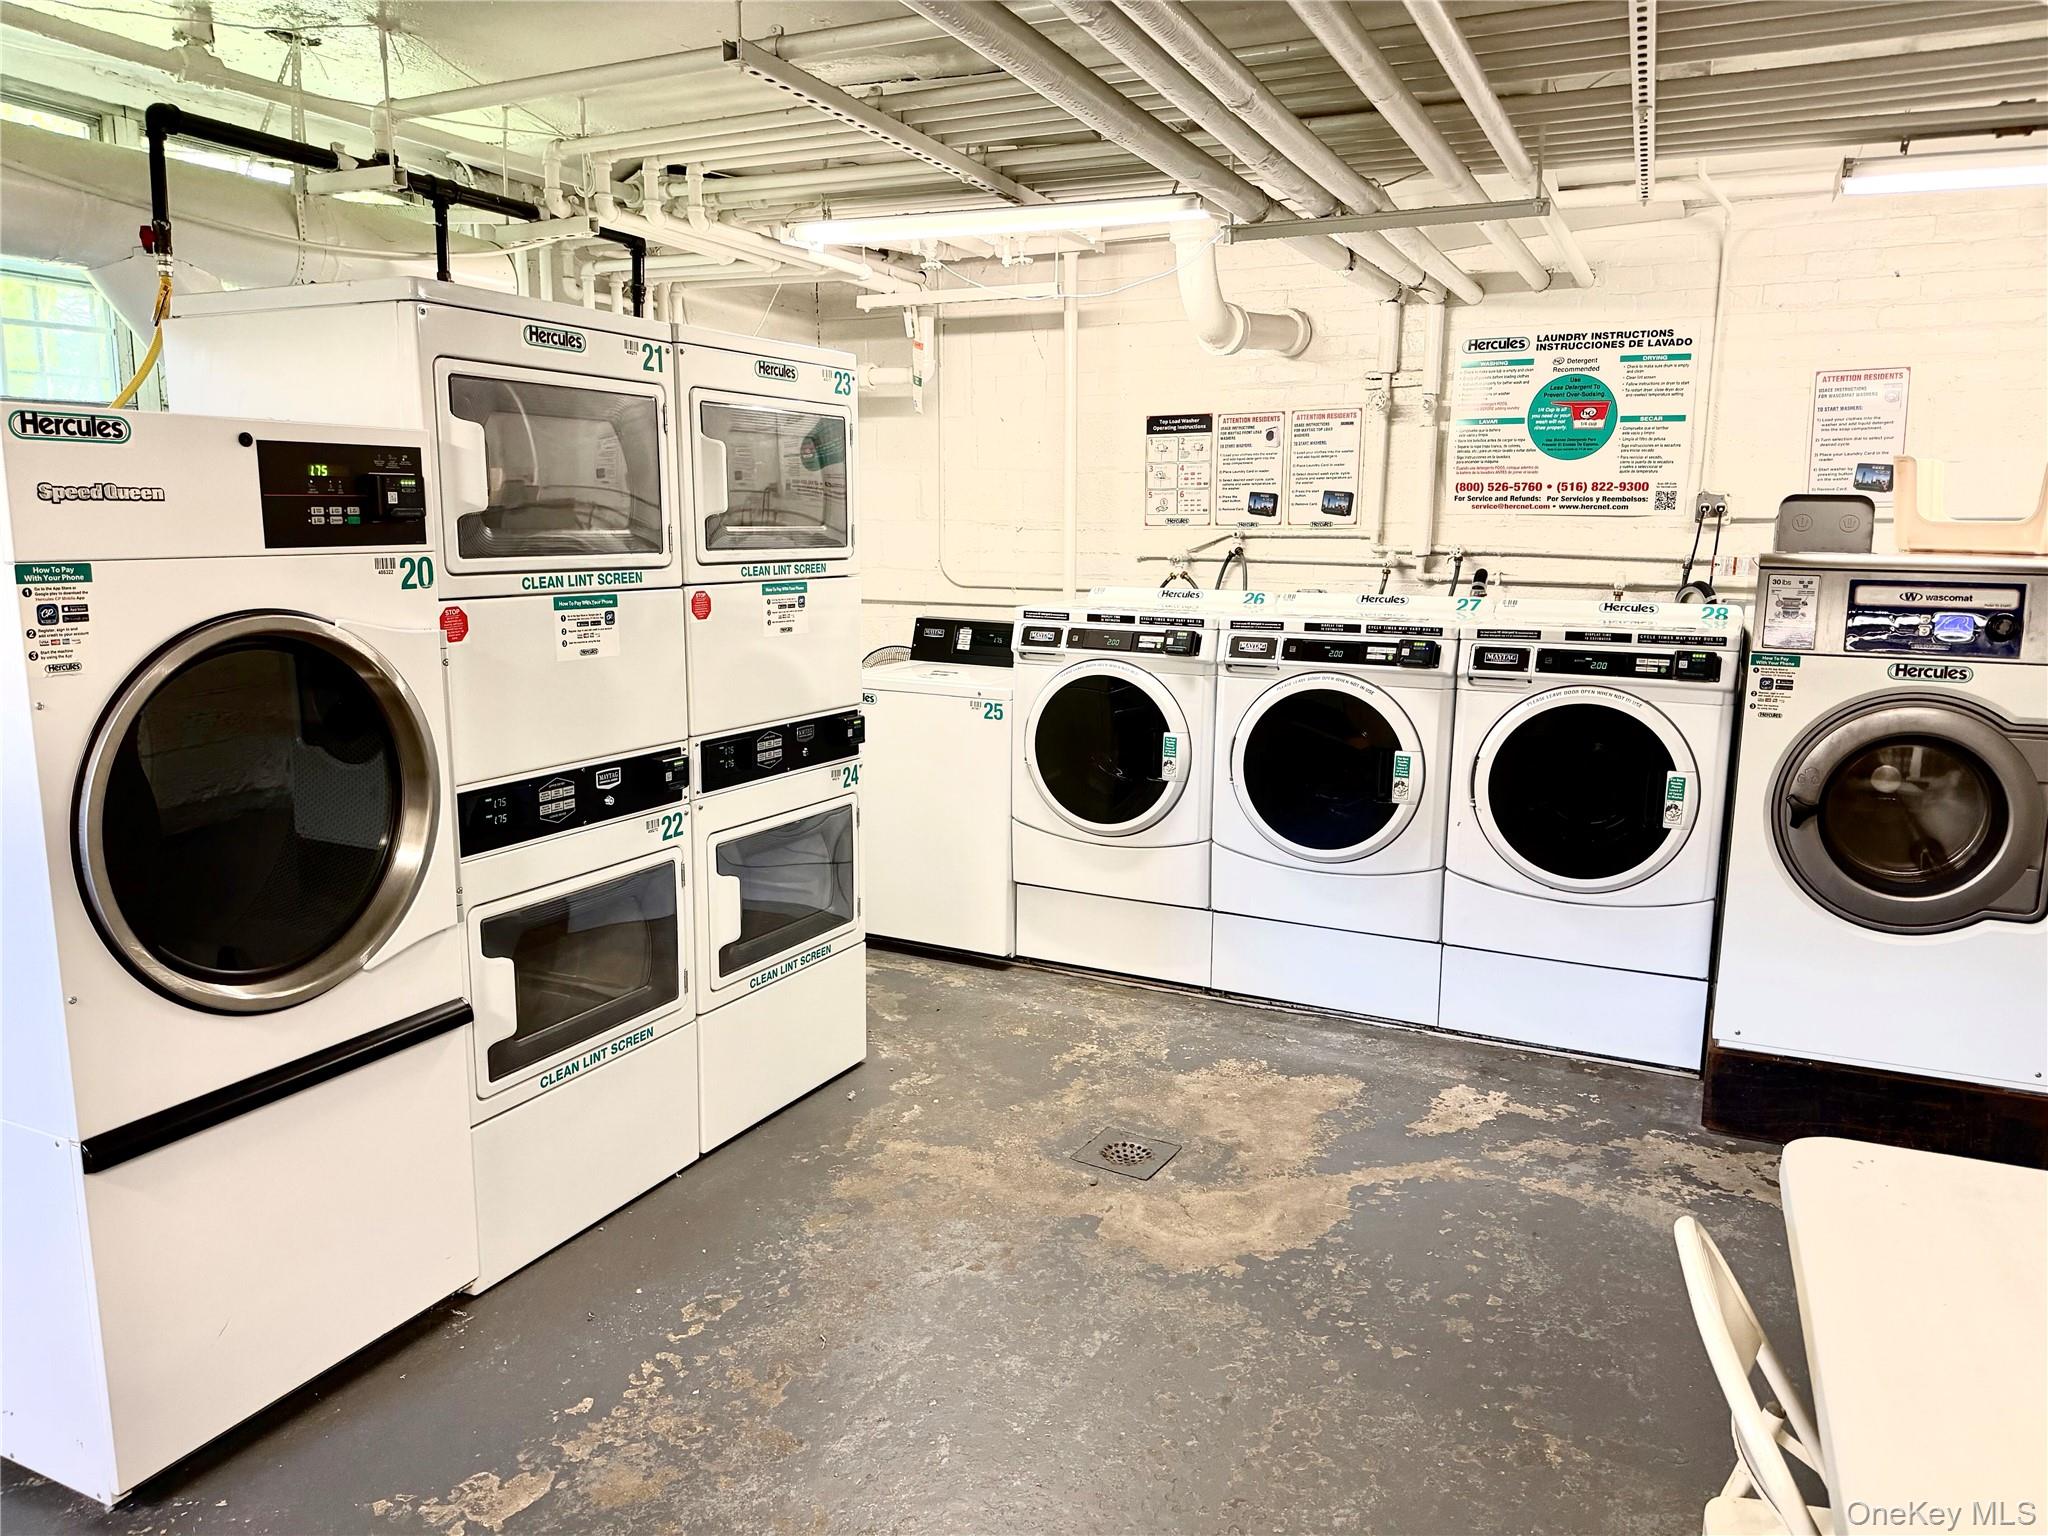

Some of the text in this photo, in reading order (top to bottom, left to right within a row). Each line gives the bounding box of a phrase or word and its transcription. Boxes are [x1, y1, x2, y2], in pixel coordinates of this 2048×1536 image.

[529, 325, 583, 349] Hercules
[1537, 329, 1674, 343] LAUNDRY INSTRUCTIONS
[1468, 338, 1526, 351] Hercules
[1536, 338, 1693, 351] INSTRUCCIONES DE LAVADO
[642, 343, 663, 372] 21
[1567, 357, 1598, 365] Detergent
[758, 361, 796, 379] Hercules
[834, 371, 851, 396] 23
[1822, 372, 1904, 383] ATTENTION RESIDENTS
[19, 411, 124, 438] Hercules
[1252, 415, 1281, 423] RESIDENTS
[37, 482, 166, 504] Speed Queen
[1455, 482, 1484, 493] (800)
[1487, 482, 1543, 492] 526-5760
[1556, 482, 1588, 493] (516)
[1591, 481, 1649, 492] 822-9300
[1601, 495, 1649, 503] Reembolsos:
[51, 566, 60, 574] To
[61, 566, 75, 574] Pay
[400, 556, 434, 590] 20
[741, 563, 827, 577] CLEAN LINT SCREEN
[24, 573, 85, 582] With Your Phone
[522, 571, 643, 590] CLEAN LINT SCREEN
[1161, 590, 1200, 599] Hercules
[1243, 592, 1266, 605] 26
[1360, 594, 1406, 604] Hercules
[1925, 593, 1973, 602] wascomat
[1455, 598, 1482, 611] 27
[1604, 602, 1655, 613] Hercules
[1701, 606, 1729, 621] 28
[28, 630, 34, 638] 2
[30, 652, 36, 660] 3
[1487, 653, 1517, 661] MAYTAG
[48, 663, 80, 672] Hercules
[1894, 663, 1967, 680] Hercules
[1526, 697, 1545, 708] PLEASE
[1545, 691, 1562, 700] LEAVE
[1597, 690, 1613, 698] WHEN
[1632, 700, 1643, 709] USE
[983, 702, 1004, 721] 25
[599, 771, 619, 781] MAYTAG
[843, 764, 859, 788] 24
[661, 812, 684, 842] 22
[749, 944, 832, 989] CLEAN LINT SCREEN
[540, 1026, 655, 1089] CLEAN LINT SCREEN
